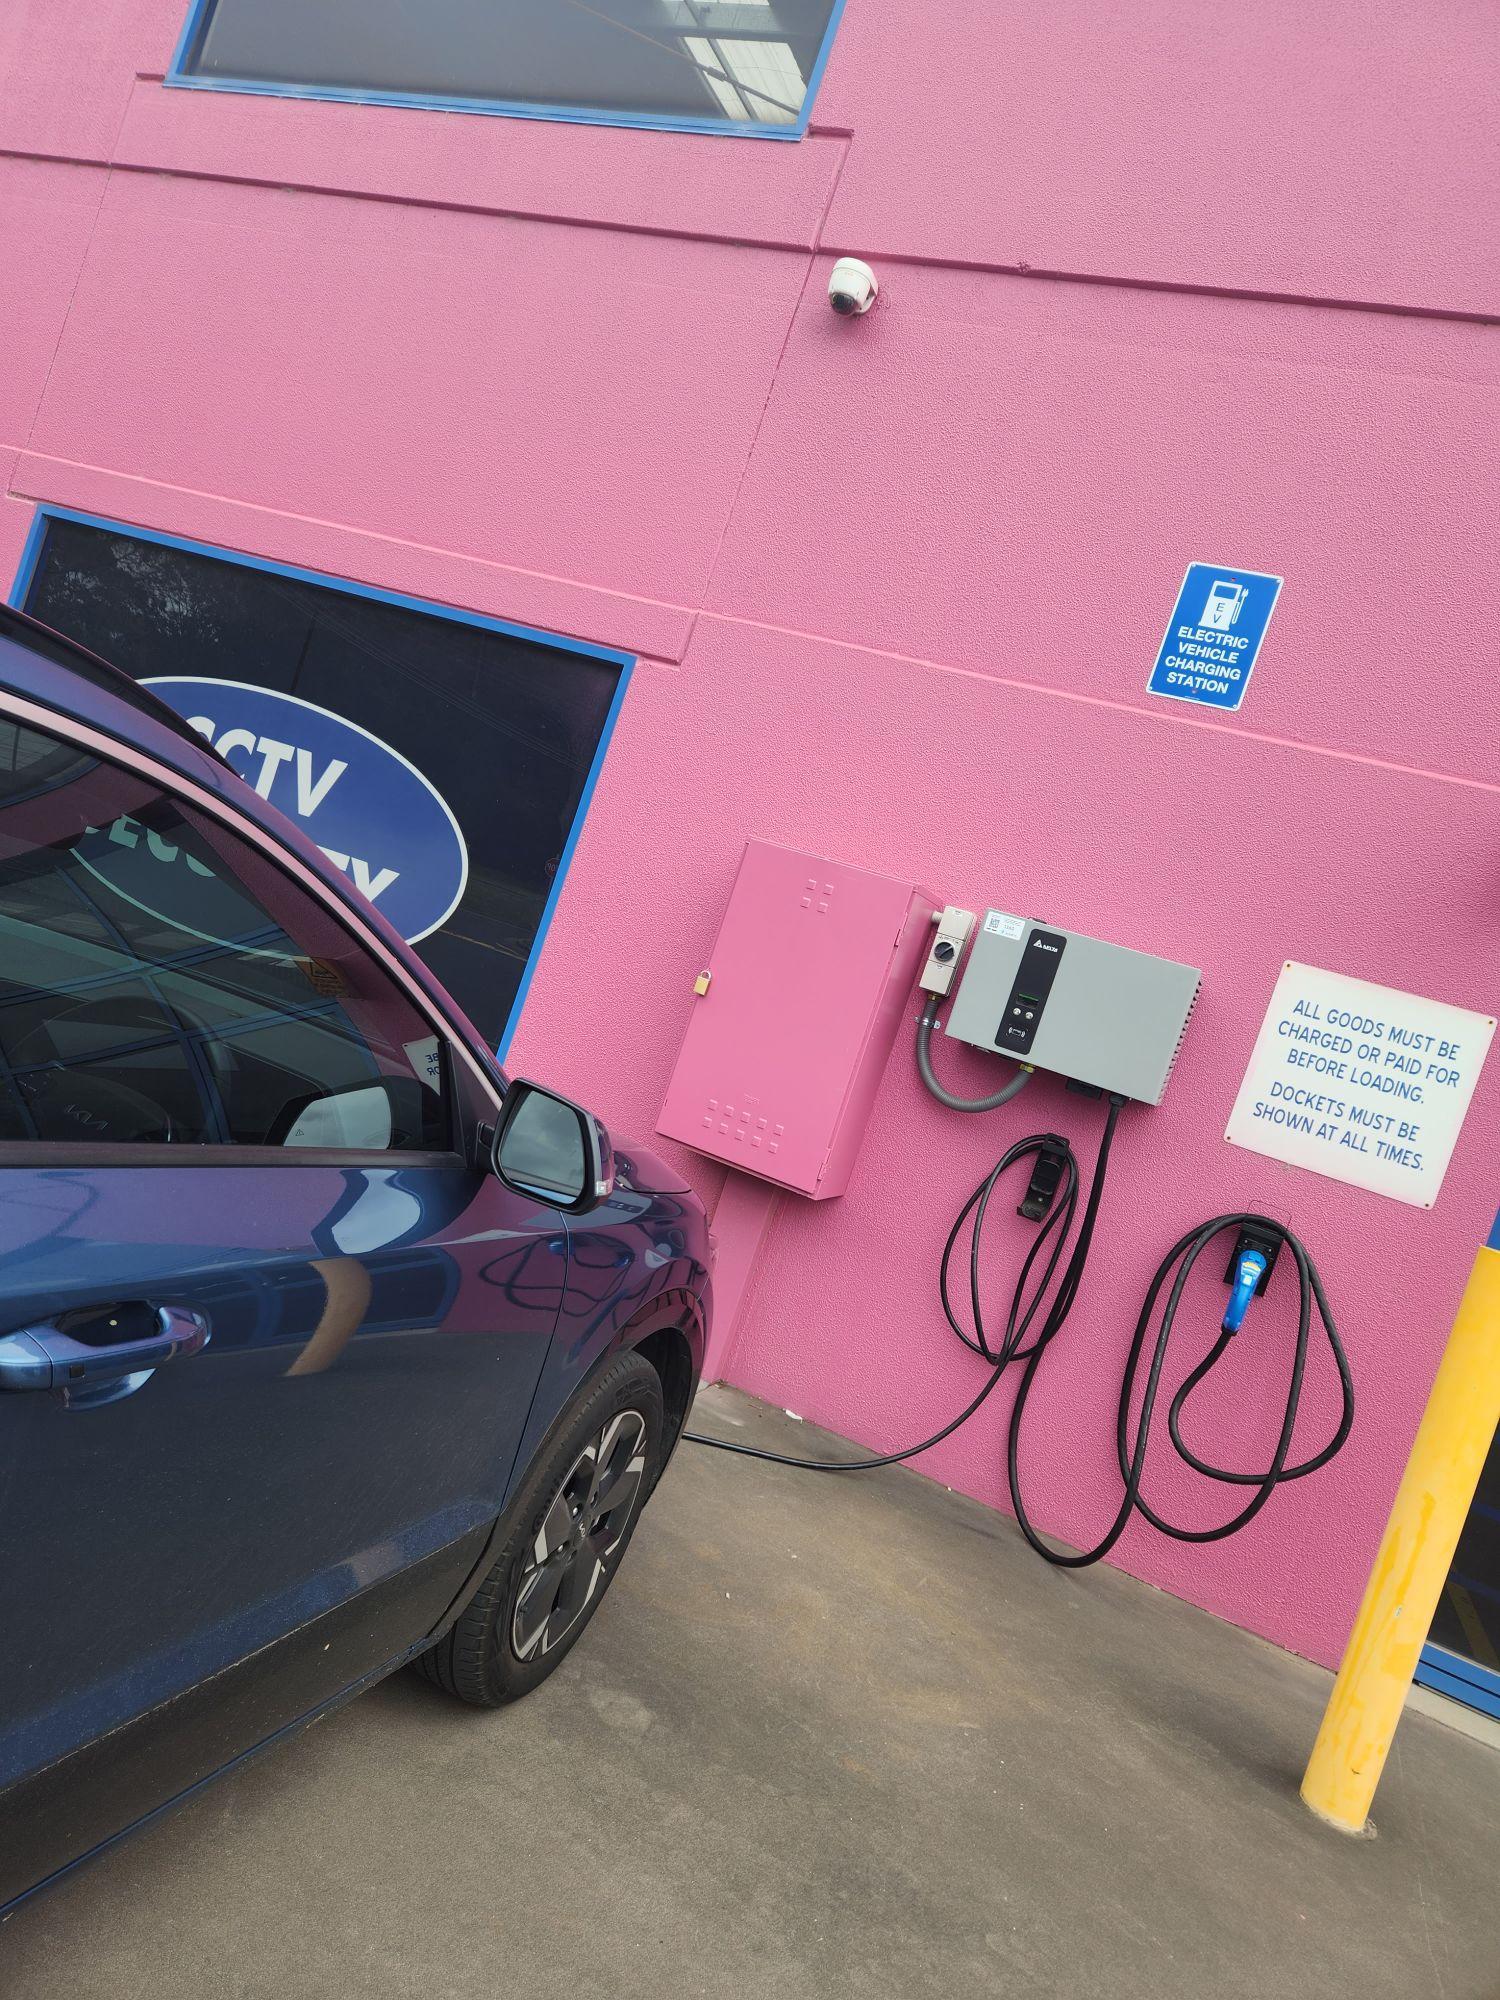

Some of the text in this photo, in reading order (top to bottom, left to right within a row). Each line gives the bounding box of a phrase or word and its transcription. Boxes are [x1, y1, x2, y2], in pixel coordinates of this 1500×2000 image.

[1178, 626, 1249, 650] ELECTRIC
[1179, 641, 1240, 664] VEHICLE
[1165, 656, 1242, 681] CHARGING
[1166, 671, 1230, 694] STATION
[1278, 1020, 1461, 1088] CHARGED OR PAID FOR
[1293, 999, 1461, 1061] ALL GOODS MUST BE
[1286, 1048, 1425, 1104] BEFORE LOADING.
[1253, 1102, 1424, 1172] SHOWN AT ALL TIMES.
[1270, 1081, 1421, 1142] DOCKETS MUST BE
